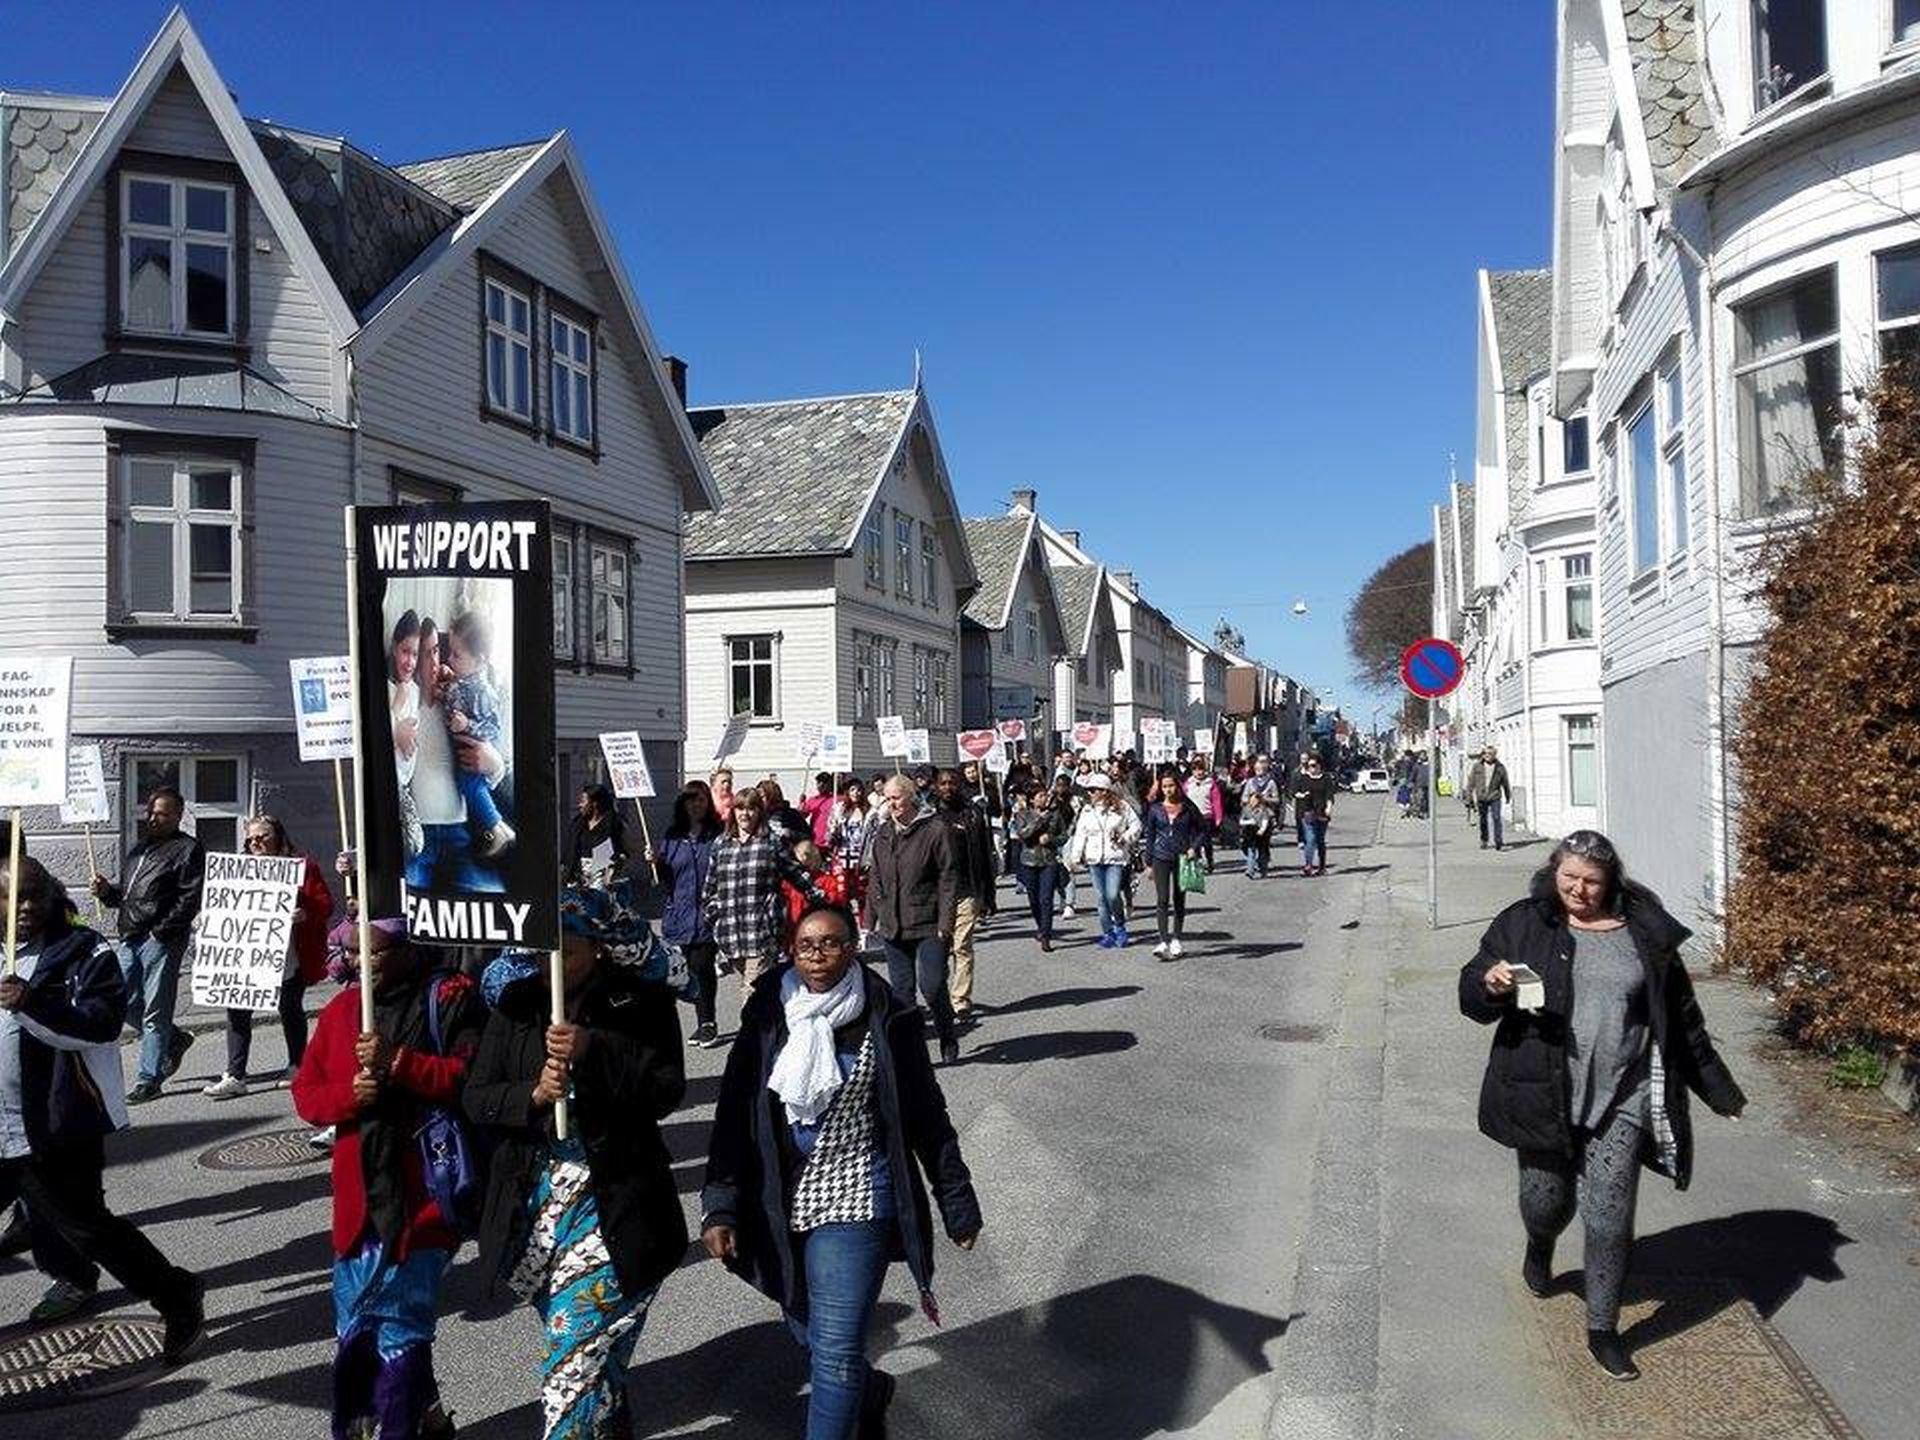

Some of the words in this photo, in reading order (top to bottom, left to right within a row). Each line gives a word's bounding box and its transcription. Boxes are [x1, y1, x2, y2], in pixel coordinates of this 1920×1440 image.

[373, 524, 411, 570] WE
[413, 520, 537, 571] SUPPORT
[207, 855, 304, 885] BARNEVERNET
[205, 887, 293, 913] BRYTER
[401, 878, 532, 942] FAMILY
[201, 915, 285, 945] LOVER
[197, 943, 244, 968] HVER
[211, 972, 257, 987] NULL
[205, 986, 282, 1008] STRAFF!
